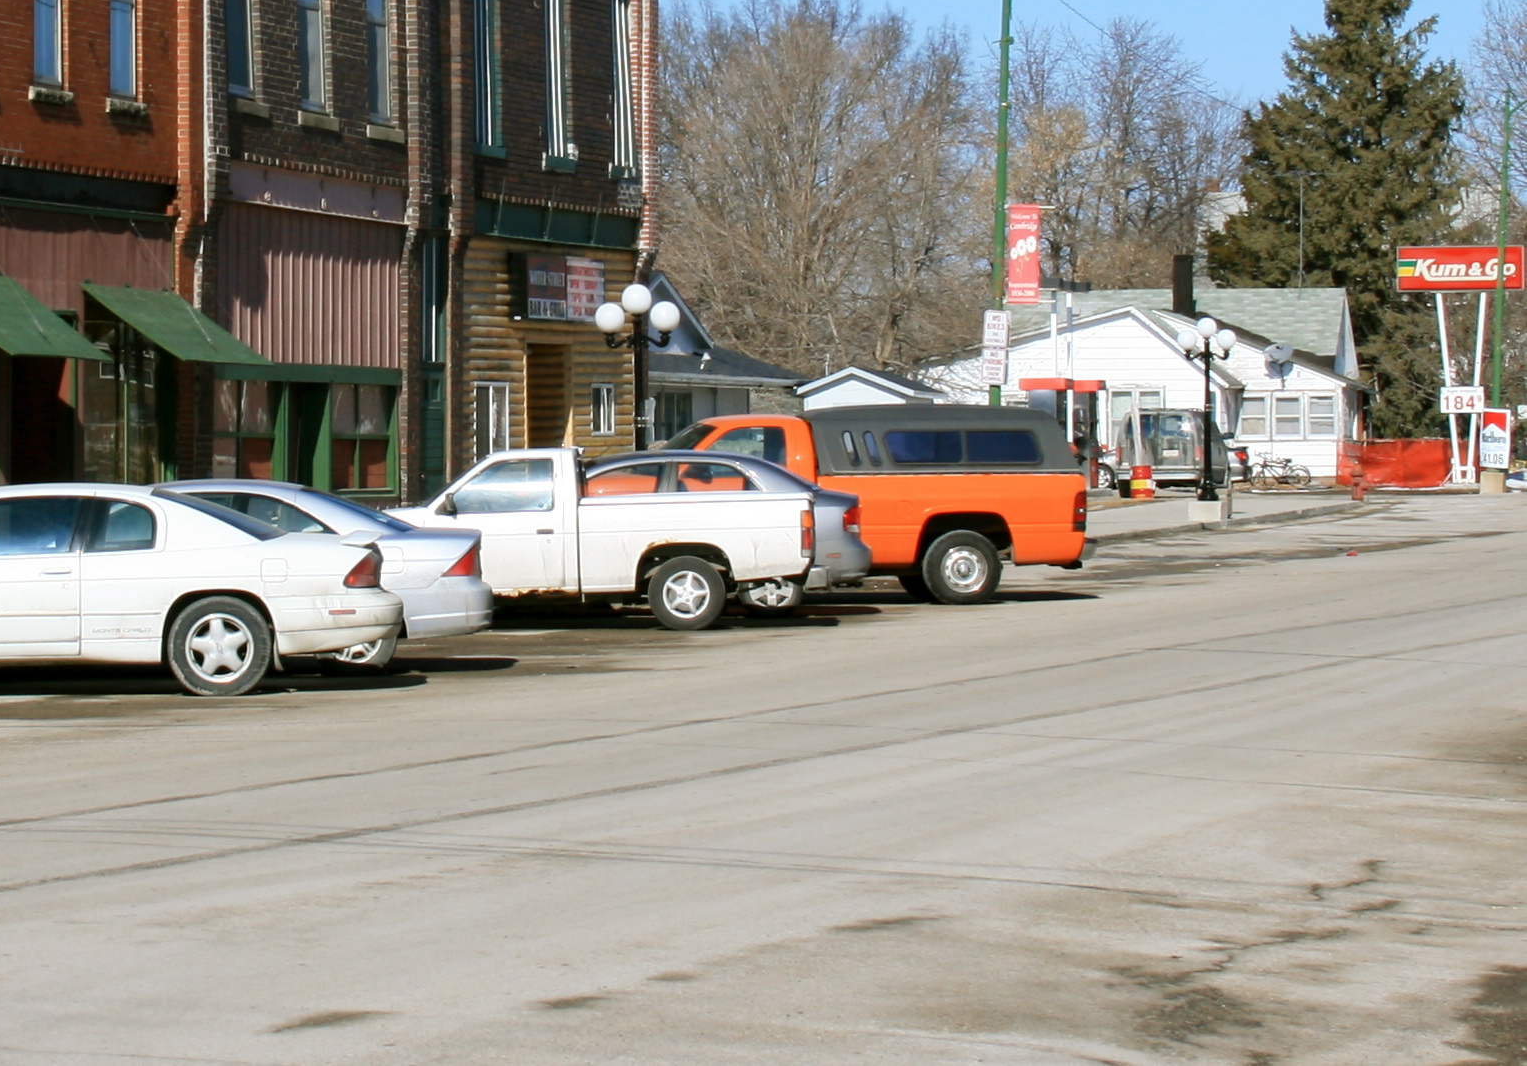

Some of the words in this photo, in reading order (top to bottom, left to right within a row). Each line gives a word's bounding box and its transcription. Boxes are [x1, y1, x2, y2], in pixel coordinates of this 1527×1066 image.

[1009, 221, 1038, 232] Cambridge
[1414, 258, 1466, 277] Kum
[1468, 261, 1483, 277] &
[1443, 394, 1476, 411] 184
